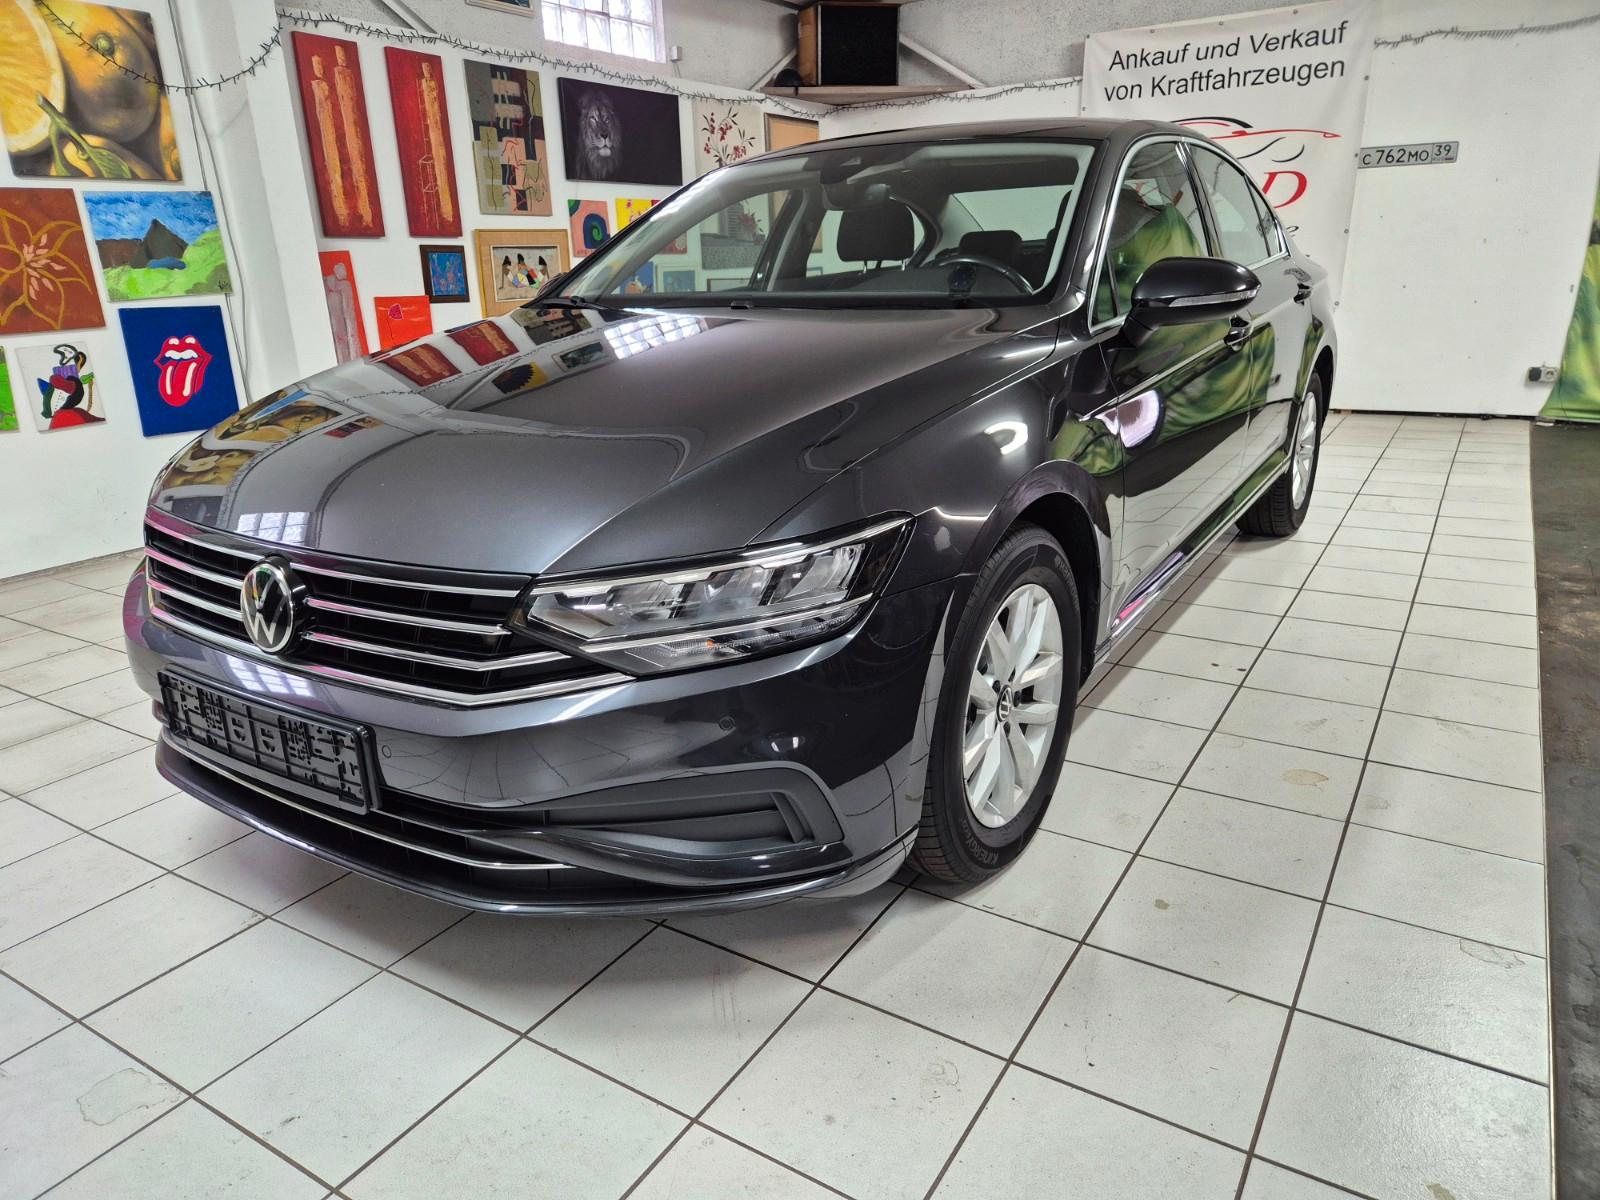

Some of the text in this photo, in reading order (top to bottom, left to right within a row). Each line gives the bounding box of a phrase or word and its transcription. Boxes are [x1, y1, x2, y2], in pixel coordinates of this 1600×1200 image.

[1108, 20, 1349, 71] Ankauf und Verkauf
[1104, 59, 1345, 101] von Kraftfahrzeugen
[1434, 144, 1452, 156] 39
